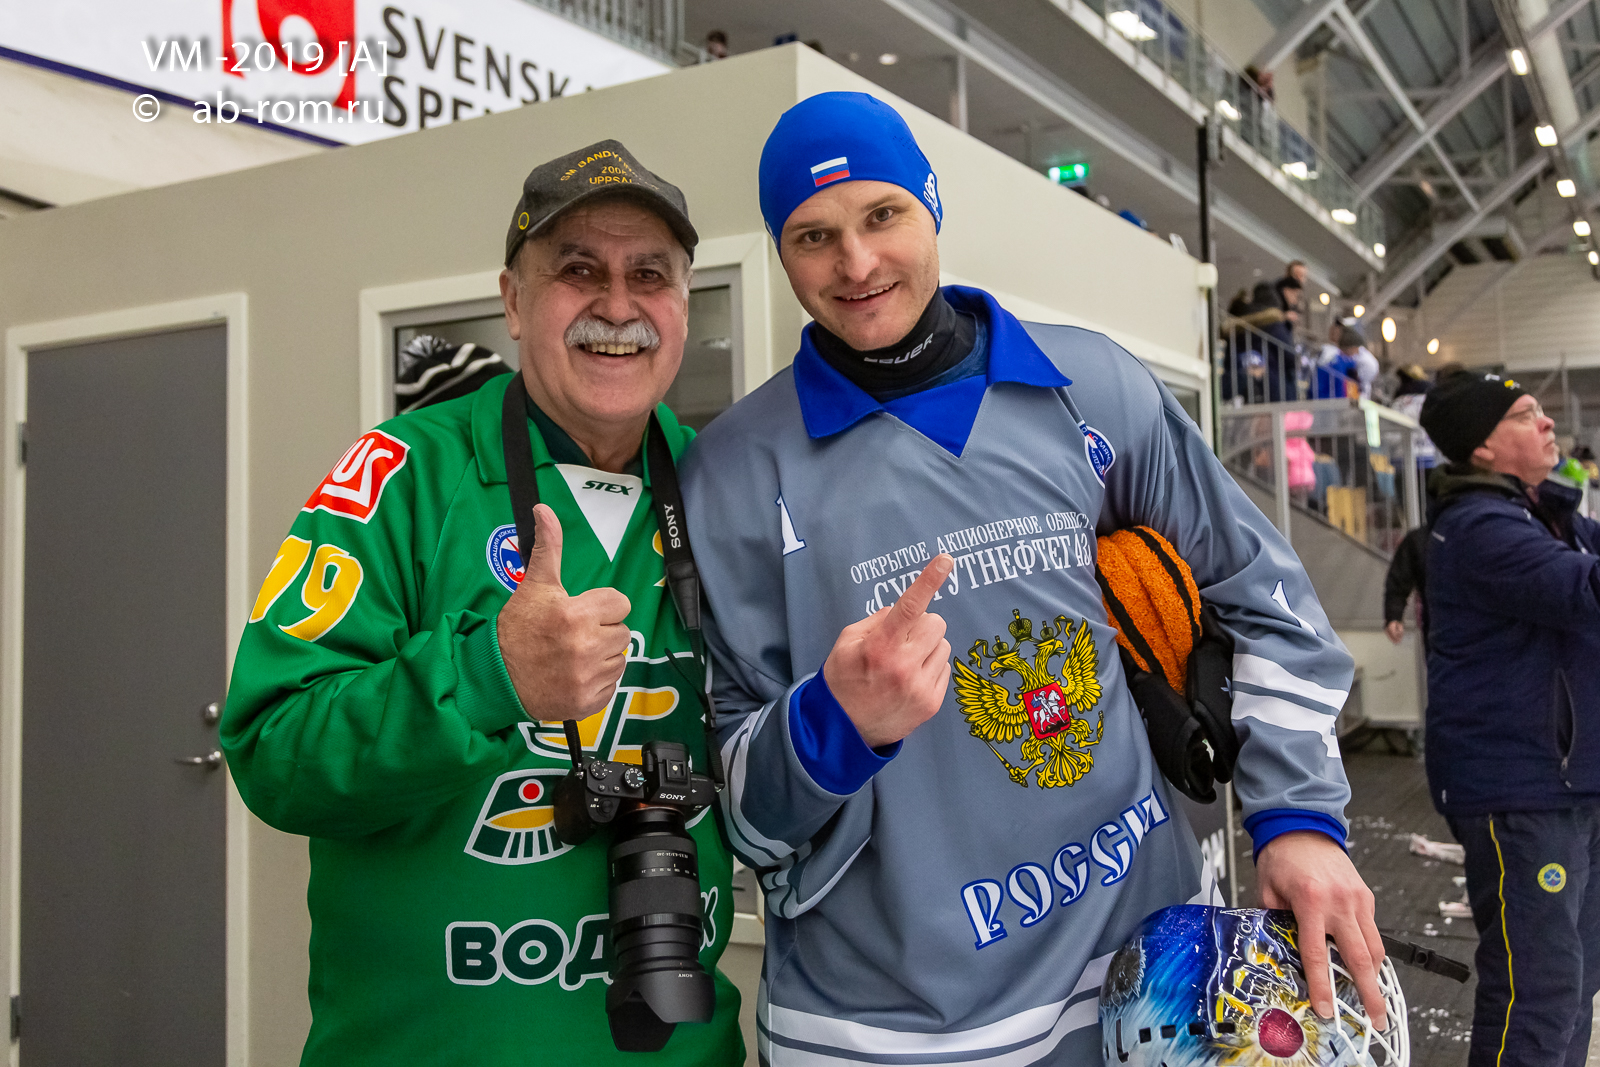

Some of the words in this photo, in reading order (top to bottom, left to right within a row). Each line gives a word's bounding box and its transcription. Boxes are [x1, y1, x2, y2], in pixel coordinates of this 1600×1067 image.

[382, 6, 593, 107] SVENSK
[383, 75, 492, 131] SP
[589, 175, 632, 185] UPPSA
[582, 480, 634, 496] STEX
[664, 503, 681, 549] SONY
[850, 541, 931, 584] ОТКРЫТОЕ
[936, 515, 1042, 554] АКЦИОНЕРНОЕ
[1045, 511, 1094, 533] ОБЩЕС
[659, 792, 687, 801] SONY
